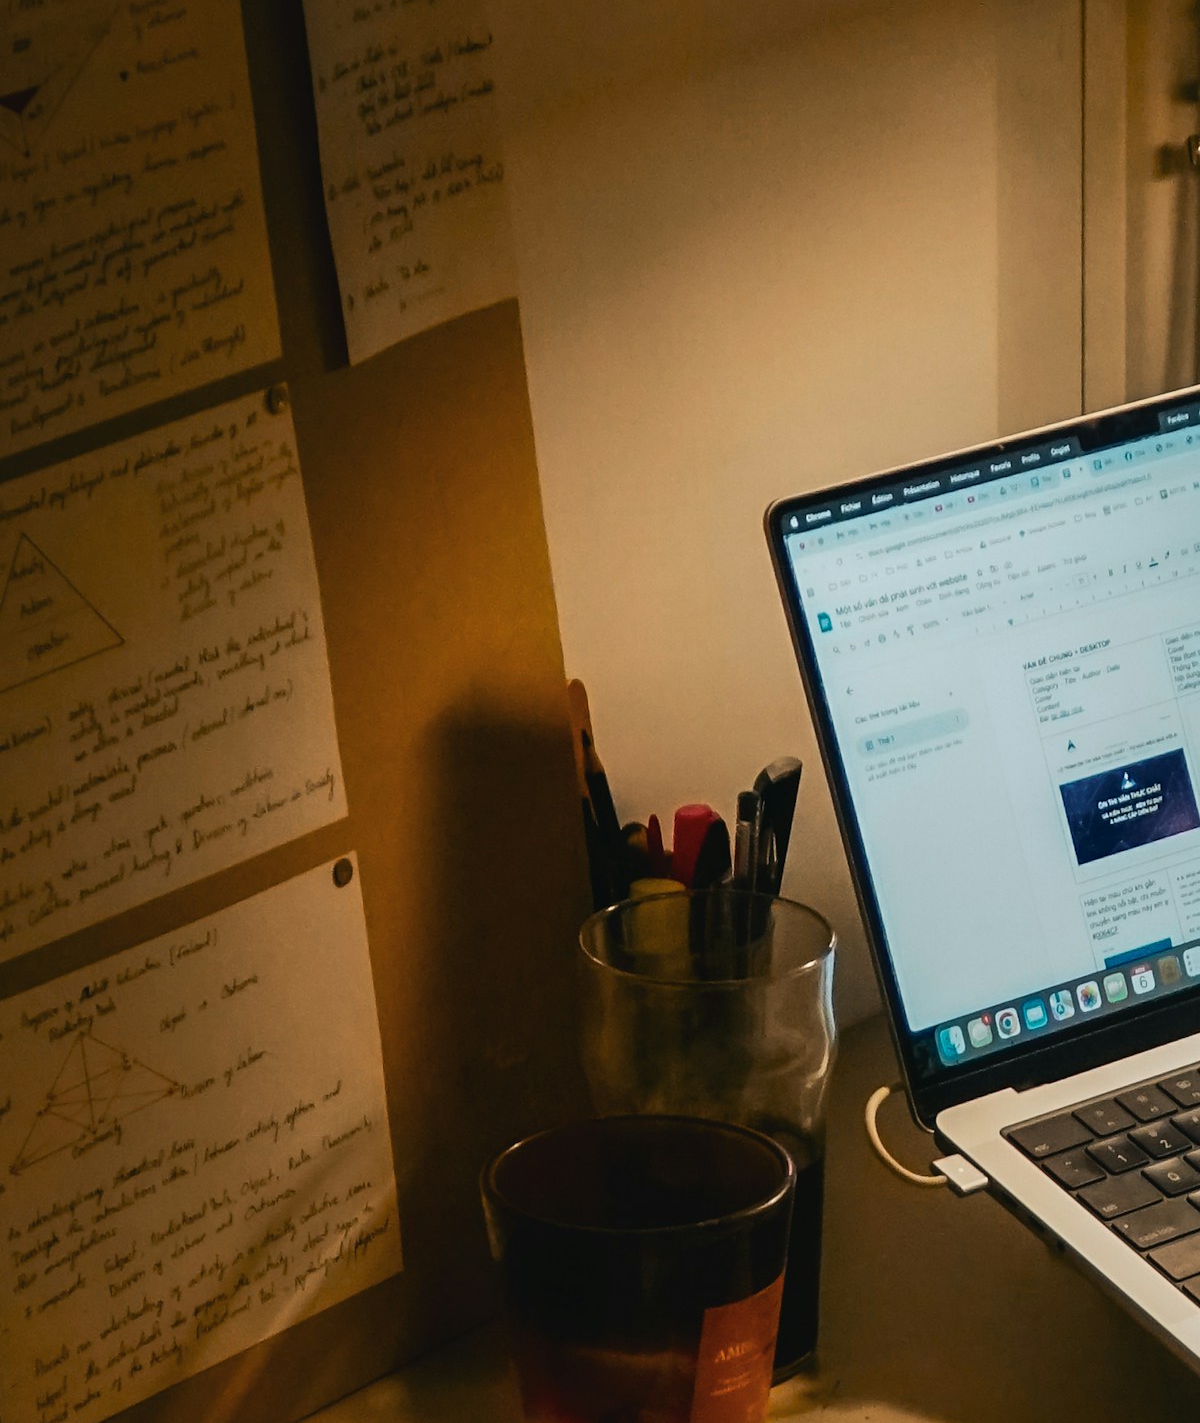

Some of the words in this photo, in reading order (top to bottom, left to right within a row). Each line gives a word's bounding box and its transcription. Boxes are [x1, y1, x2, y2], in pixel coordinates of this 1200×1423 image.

[989, 461, 1011, 472] Favoris
[949, 469, 980, 483] Historique
[902, 480, 940, 496] Présentation
[871, 493, 893, 504] Édition
[840, 501, 861, 513] Fichier
[805, 509, 831, 522] Chrome
[834, 605, 851, 615] Một
[852, 600, 862, 611] số
[864, 599, 875, 608] vấn
[878, 594, 889, 604] đề
[889, 589, 908, 602] phát
[908, 585, 925, 595] sinh
[925, 581, 937, 590] với
[938, 573, 967, 587] website
[1048, 651, 1073, 662] CHUNG
[1079, 638, 1110, 654] DESKTOP
[1138, 975, 1148, 988] 6
